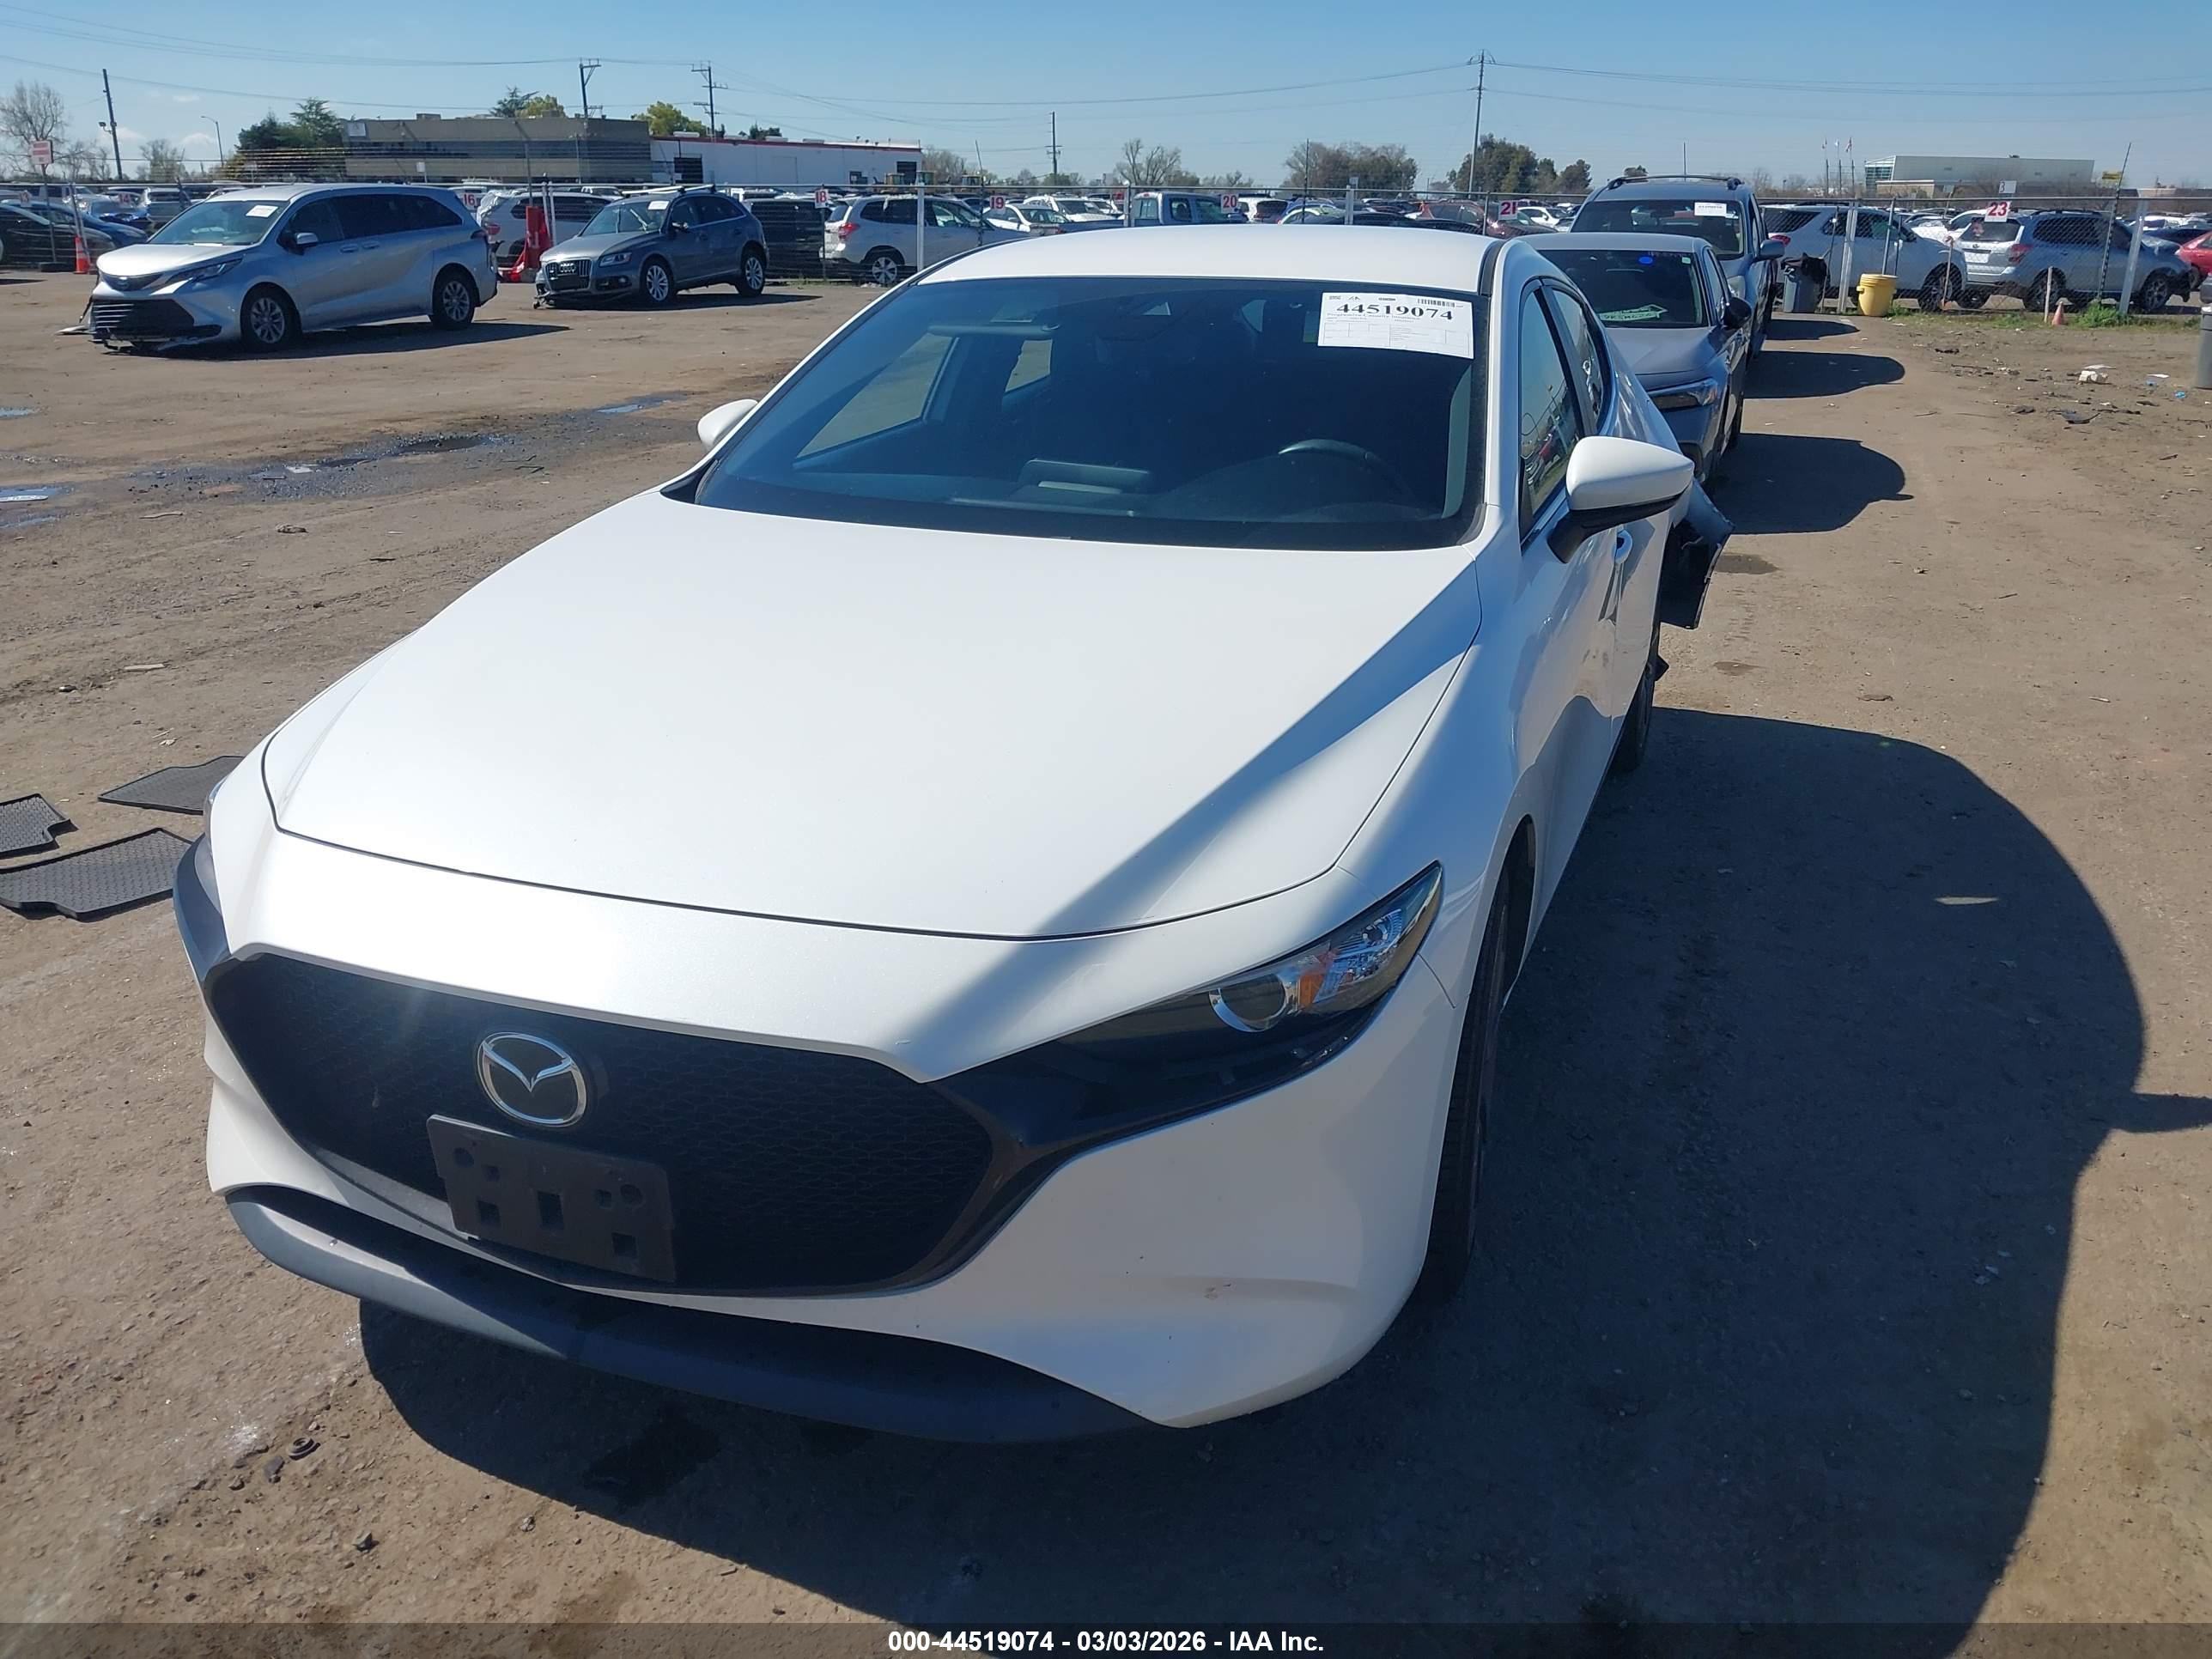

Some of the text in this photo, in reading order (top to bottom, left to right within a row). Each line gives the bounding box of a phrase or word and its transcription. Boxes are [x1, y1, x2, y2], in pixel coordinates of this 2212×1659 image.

[118, 193, 131, 204] 14
[463, 193, 476, 206] 16
[815, 190, 827, 204] 18
[990, 197, 1004, 210] 19
[1223, 196, 1237, 208] 20
[1500, 202, 1516, 215] 21
[1989, 203, 2008, 216] 23
[1336, 303, 1453, 320] 44519074
